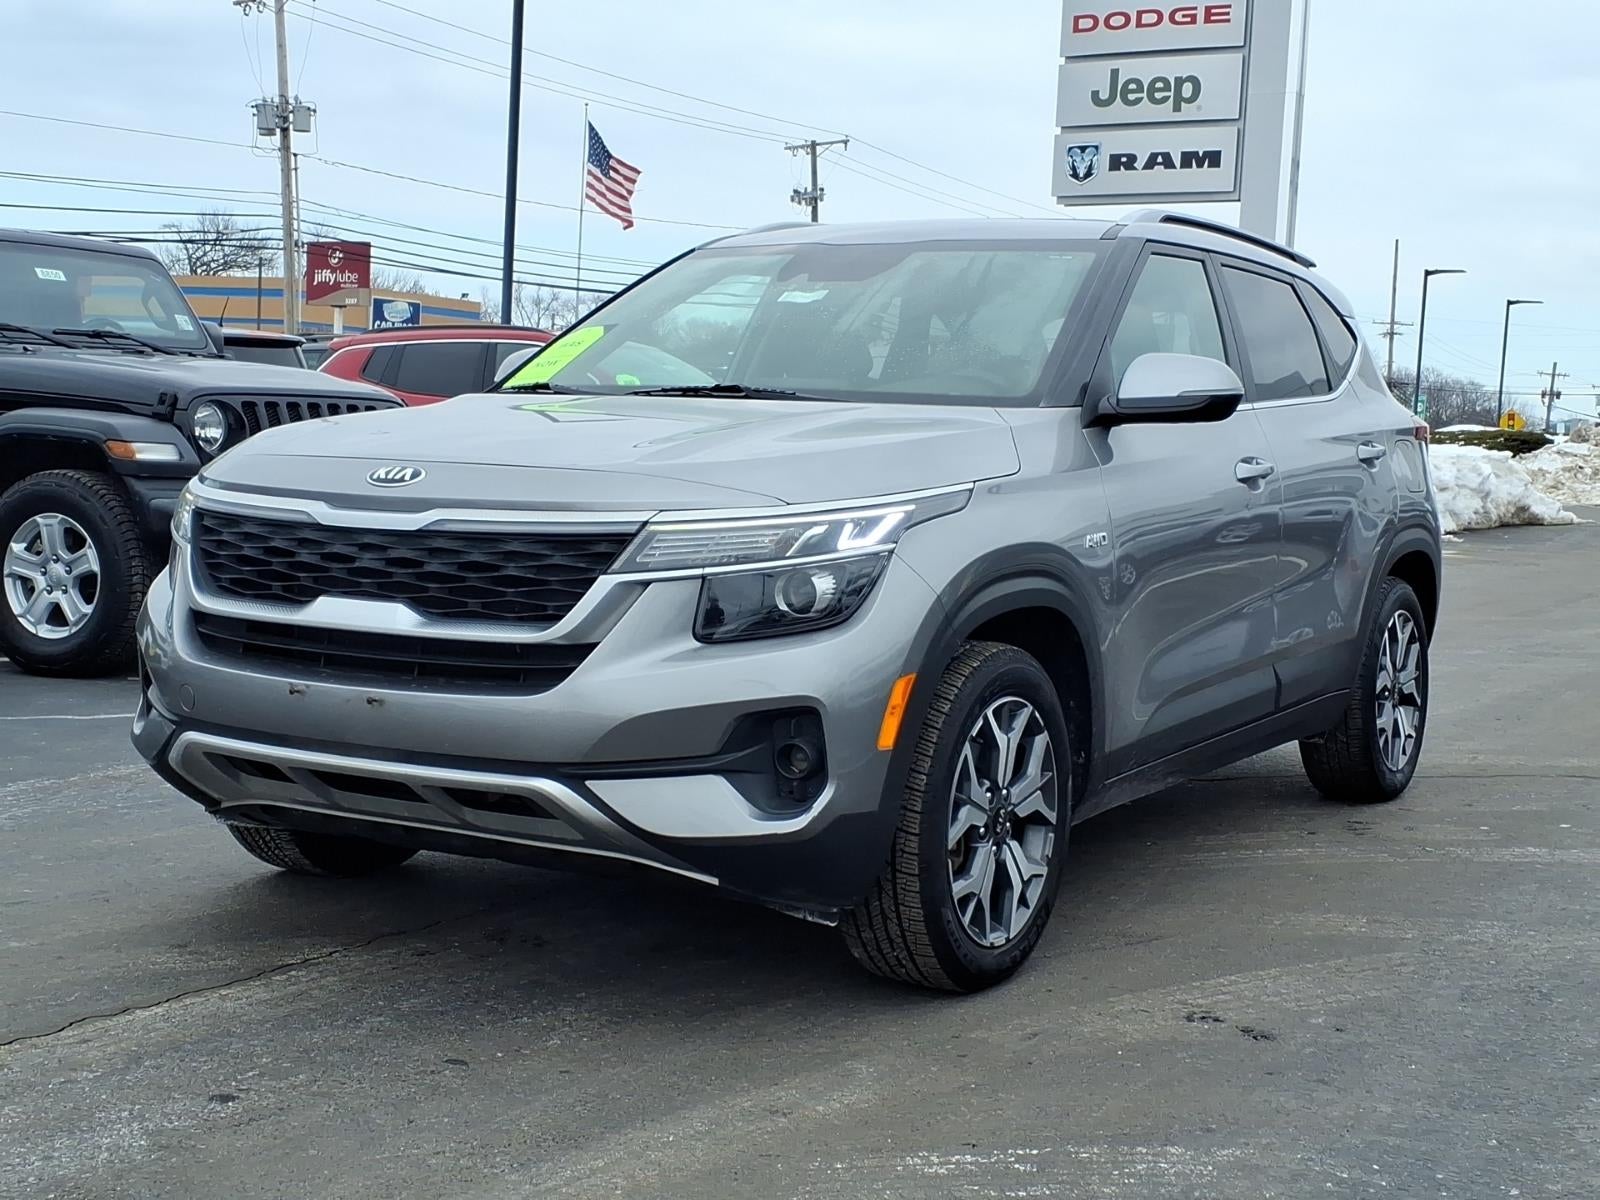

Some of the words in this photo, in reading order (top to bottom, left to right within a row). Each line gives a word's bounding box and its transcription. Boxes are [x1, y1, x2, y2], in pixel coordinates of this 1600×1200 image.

[1072, 4, 1232, 34] DODGE
[1090, 68, 1202, 113] Jeep
[1108, 150, 1222, 172] RAM
[372, 466, 415, 481] KIA
